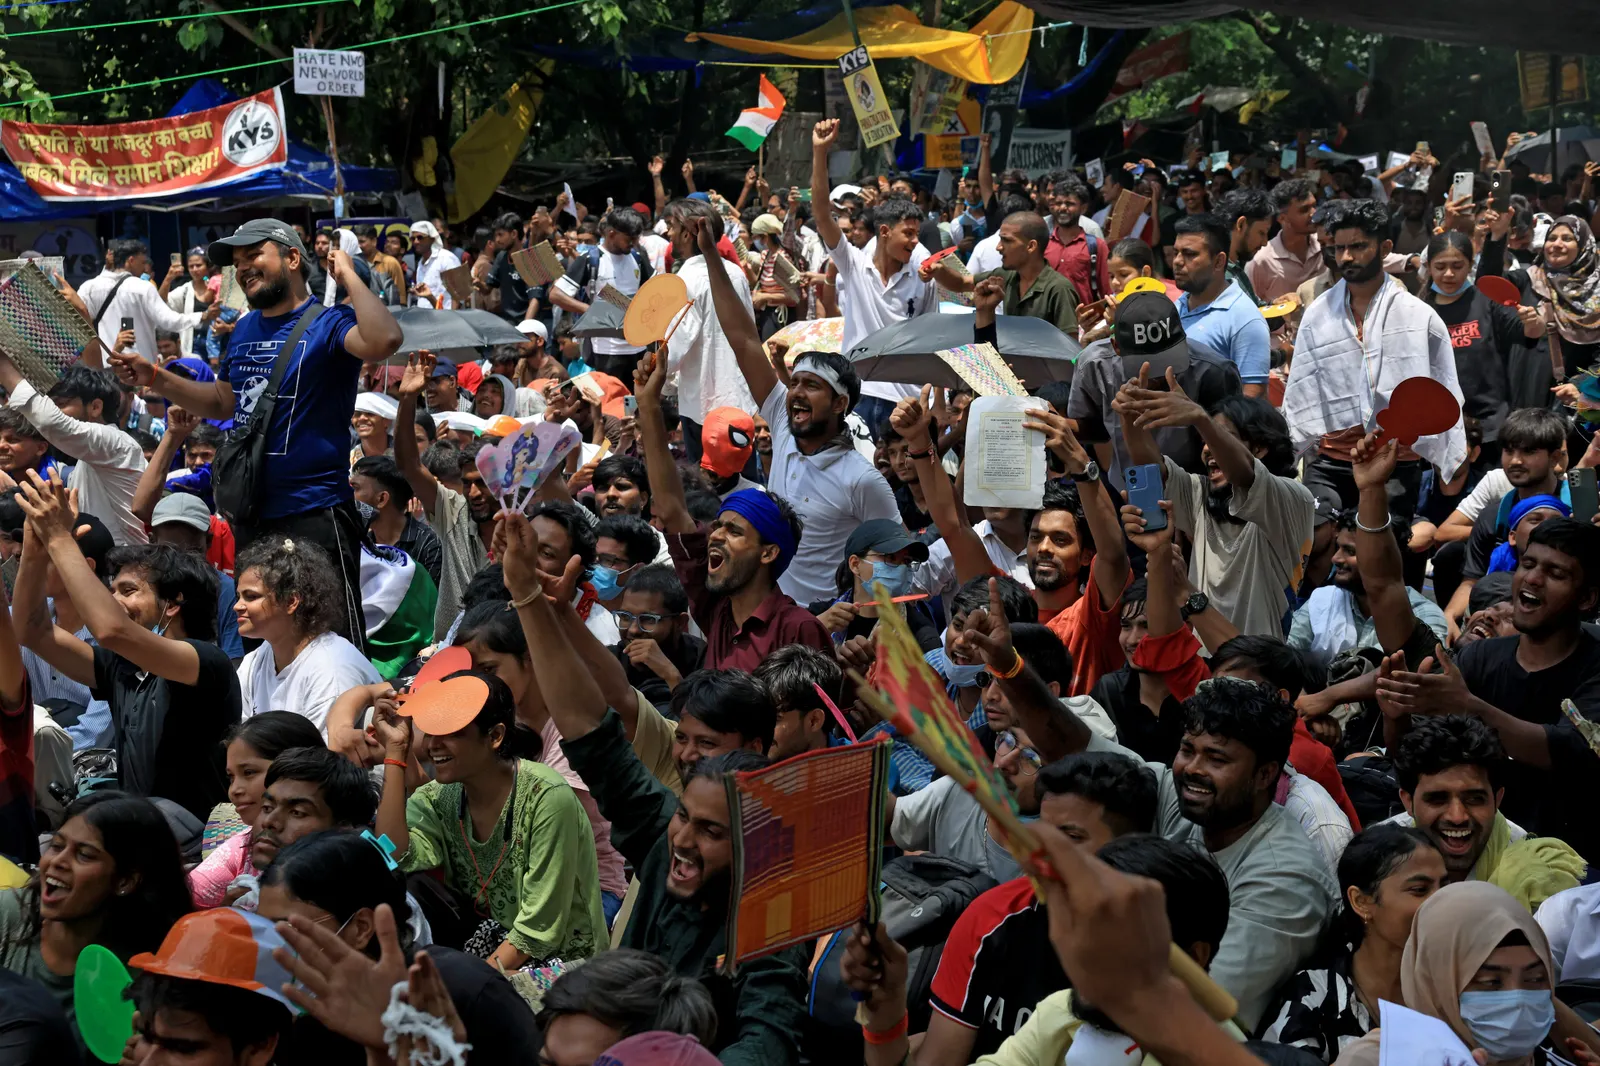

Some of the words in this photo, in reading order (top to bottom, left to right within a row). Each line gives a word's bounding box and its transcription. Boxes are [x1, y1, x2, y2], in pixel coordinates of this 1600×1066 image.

[299, 53, 336, 65] HATE
[340, 54, 364, 68] NWO
[839, 47, 868, 74] KYS
[317, 81, 357, 94] ORDER
[72, 131, 87, 156] हो
[89, 136, 109, 154] या
[111, 132, 153, 158] मजदूर
[154, 129, 176, 147] का
[176, 121, 214, 144] बच्चा
[228, 124, 275, 152] KYS
[68, 157, 110, 185] मिले
[112, 162, 163, 185] समान
[1134, 317, 1170, 344] BOY
